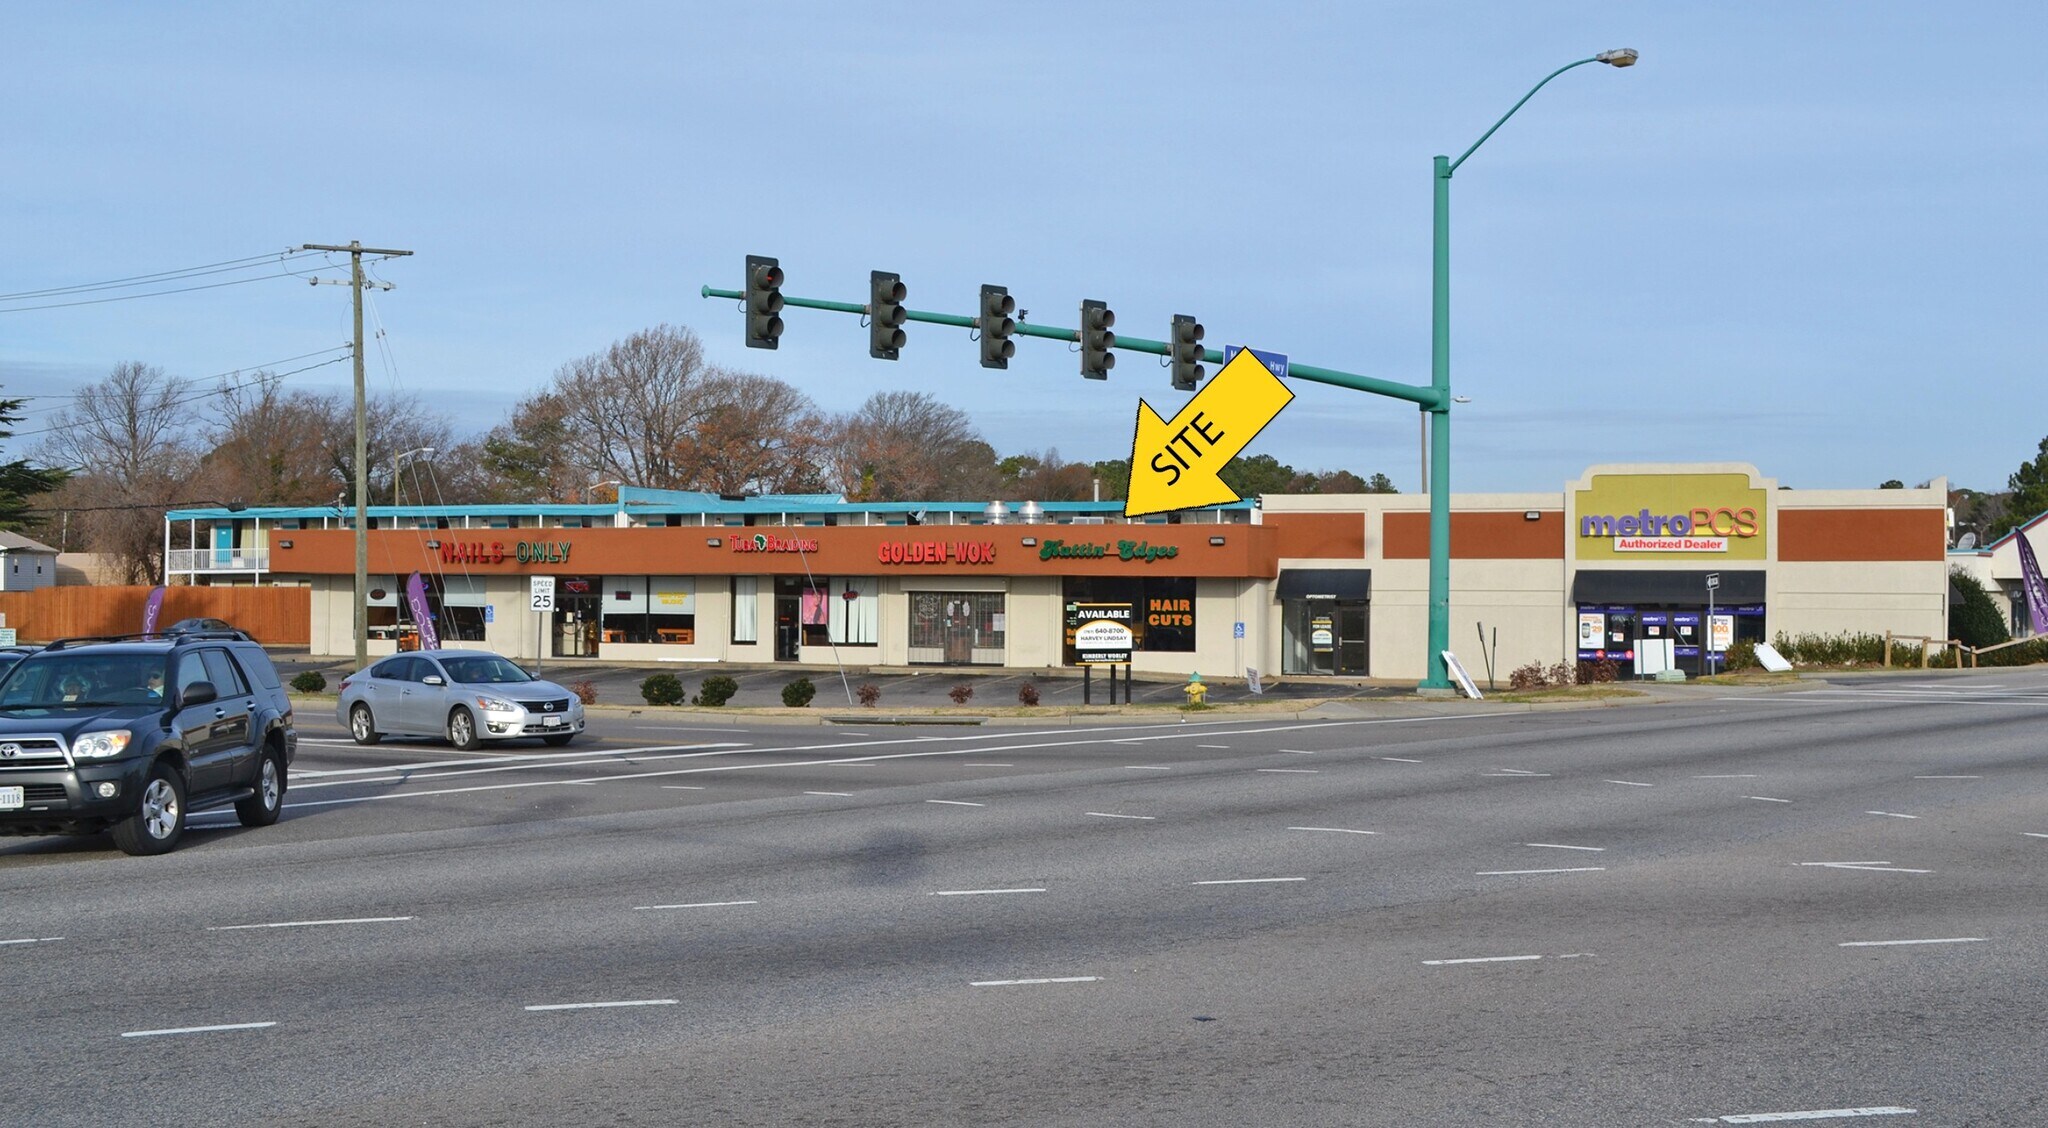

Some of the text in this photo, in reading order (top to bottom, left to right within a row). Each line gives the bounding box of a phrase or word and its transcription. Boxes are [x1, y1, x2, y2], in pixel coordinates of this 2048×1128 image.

[1270, 361, 1285, 375] Hwy
[1581, 507, 1758, 537] metroPCS
[1117, 539, 1178, 562] Edges
[1619, 539, 1723, 549] Authorized Dealer
[441, 540, 571, 564] NAILS ONLY
[878, 541, 995, 564] GOLDEN WOK
[533, 595, 551, 608] 25
[1150, 599, 1190, 611] HAIR
[1078, 610, 1131, 619] AVAILABLE
[1148, 614, 1192, 626] CUTS
